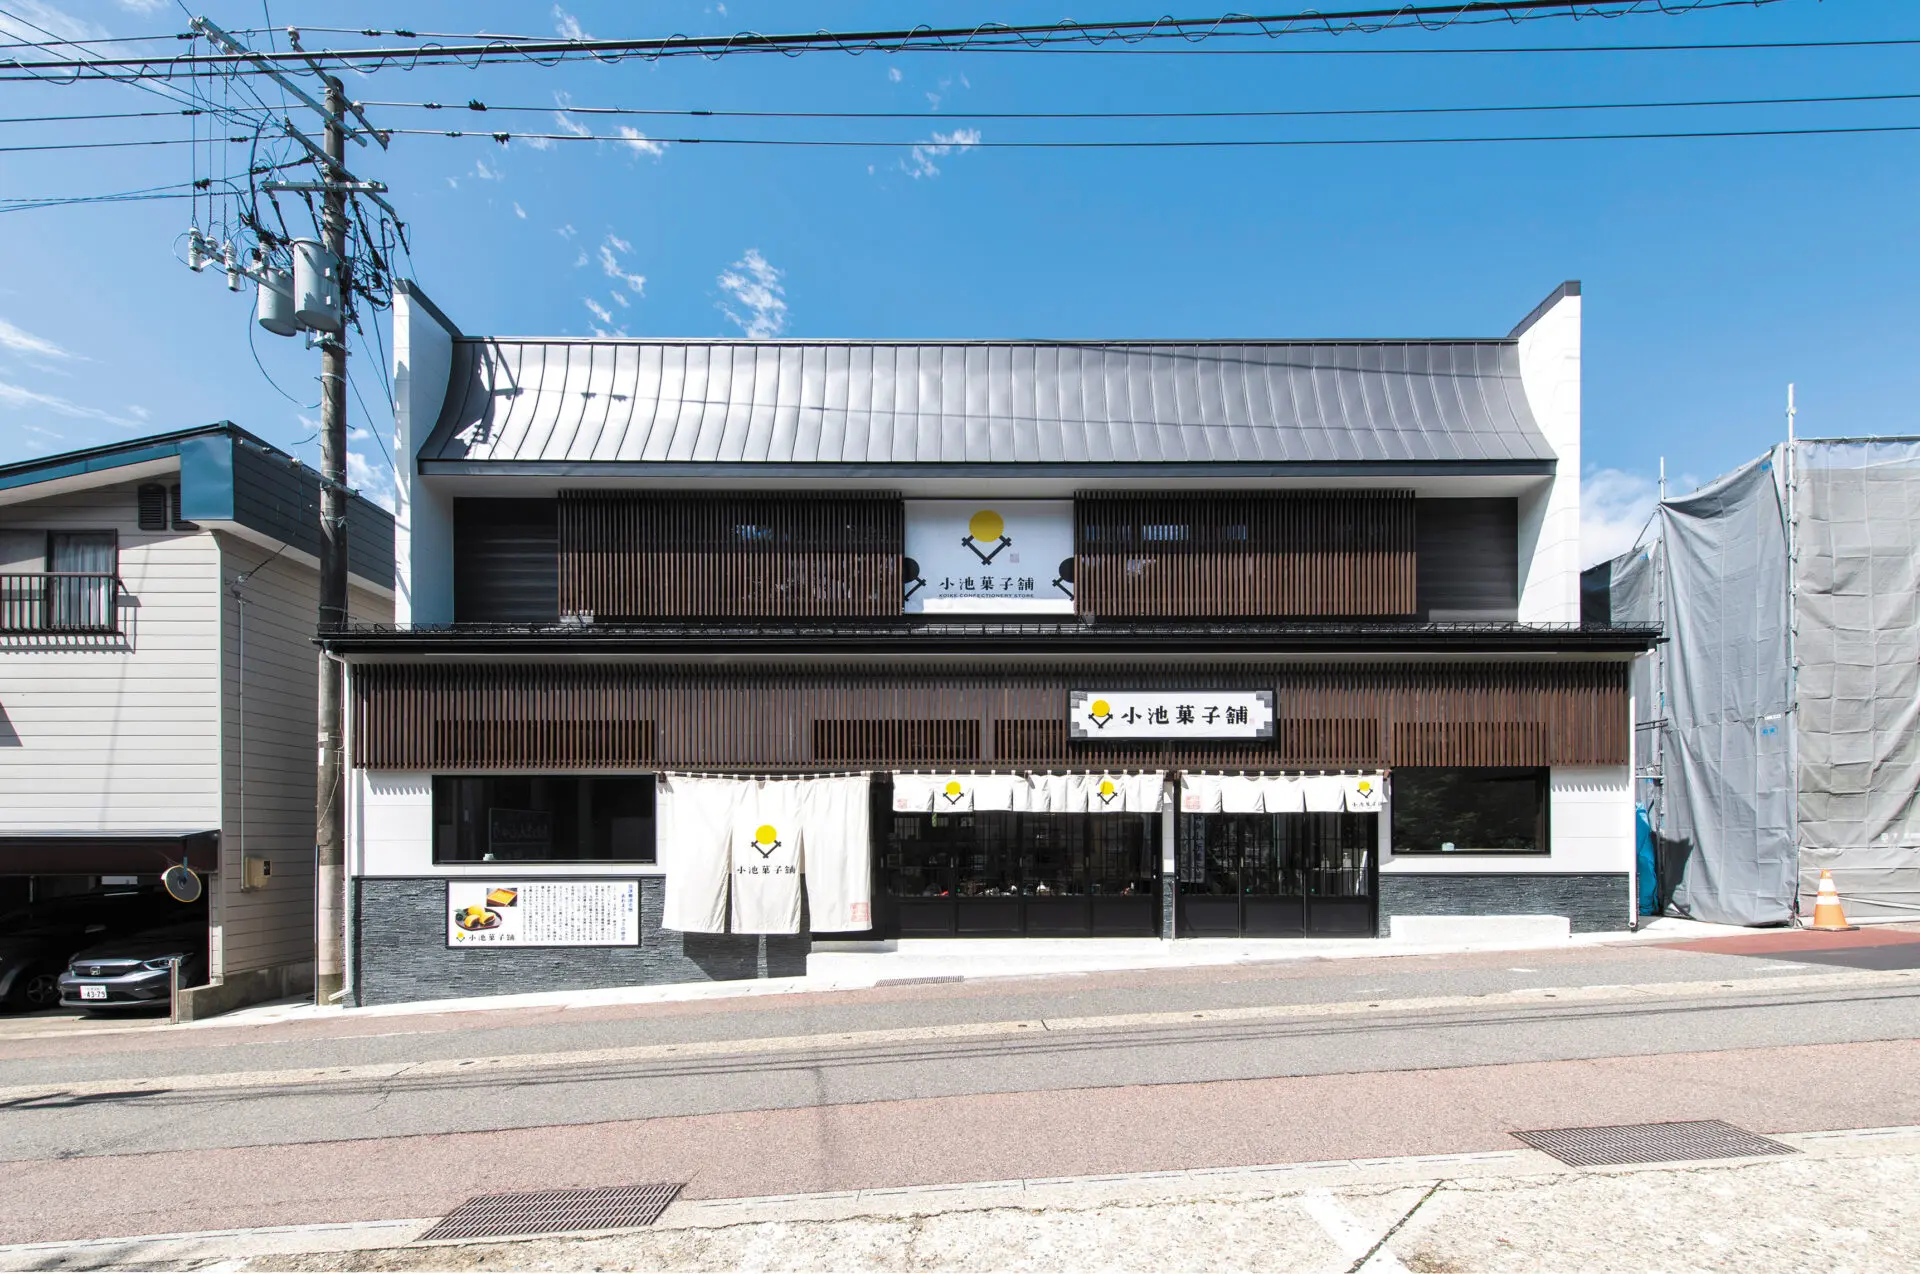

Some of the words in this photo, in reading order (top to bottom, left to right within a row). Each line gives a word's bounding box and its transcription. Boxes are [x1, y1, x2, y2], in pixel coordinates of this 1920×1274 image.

[939, 576, 1034, 591] 小池菓子舗
[1121, 705, 1249, 725] 小池菓子舗
[737, 865, 796, 875] 小池菓子舗
[469, 933, 515, 942] 小池菓子舗
